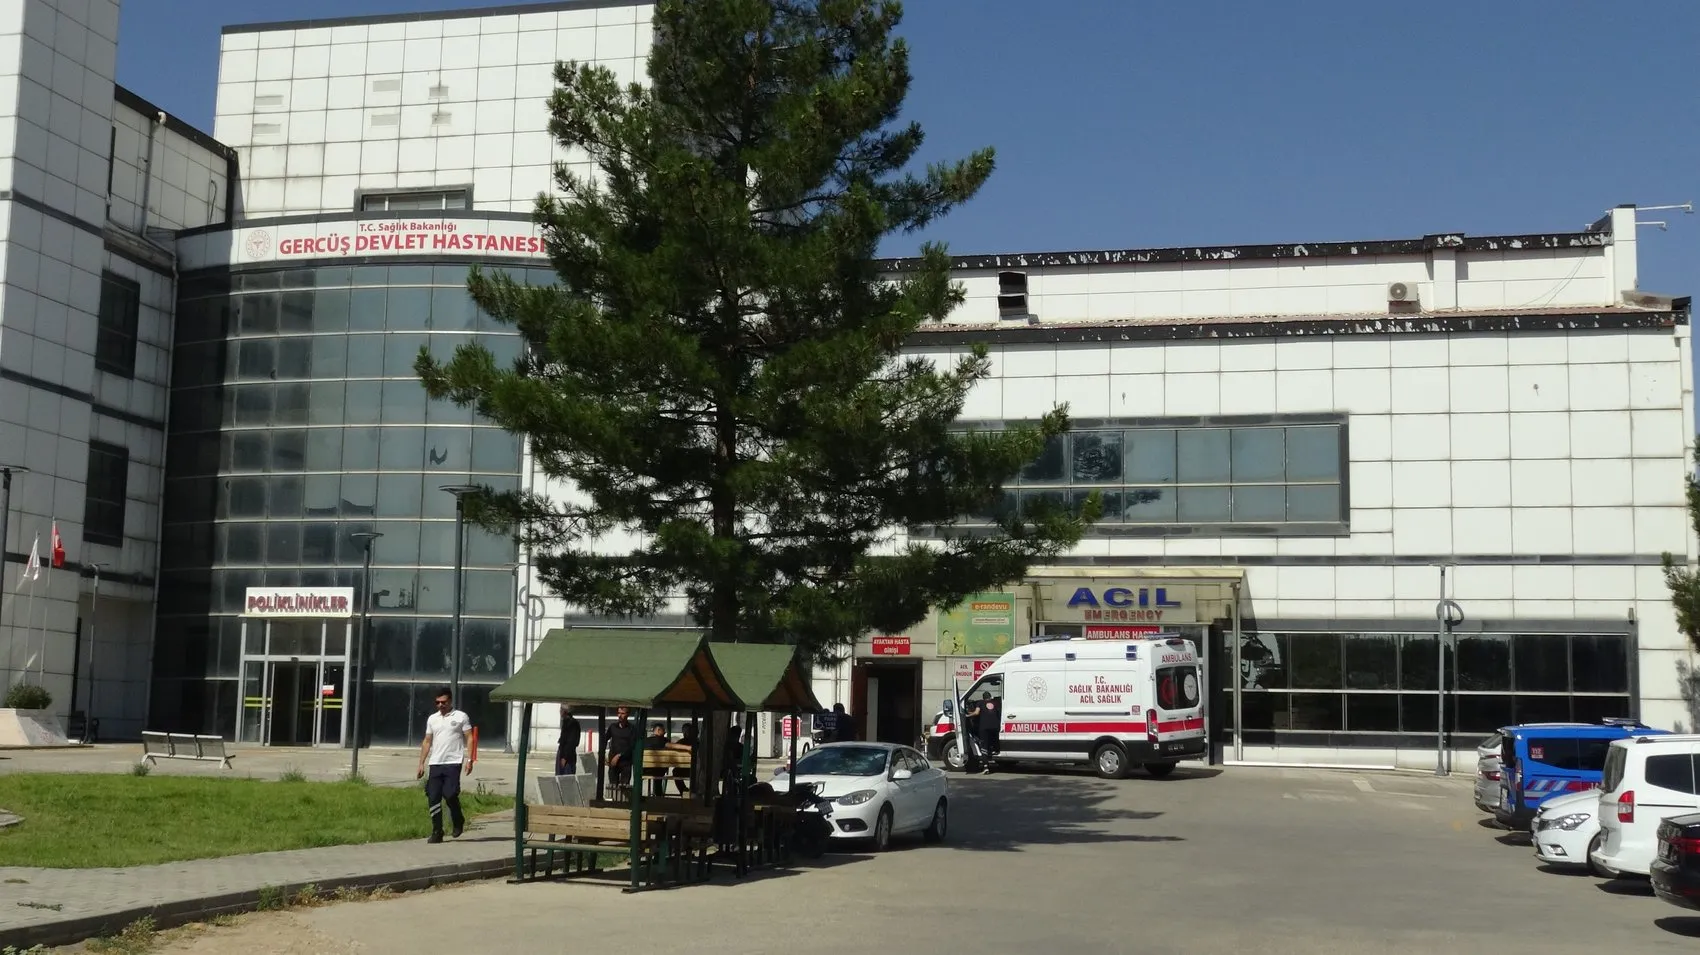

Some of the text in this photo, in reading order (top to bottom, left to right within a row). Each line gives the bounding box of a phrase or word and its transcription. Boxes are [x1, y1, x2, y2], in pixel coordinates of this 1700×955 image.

[360, 222, 457, 233] T.C. Sağlık Bakanlığı
[279, 233, 351, 255] GERCÜŞ
[355, 234, 428, 251] DEVLET
[247, 593, 348, 612] POLİKLİNİKLER
[1083, 609, 1164, 621] EMERGENCY
[1086, 630, 1130, 640] AMBULANS
[1161, 653, 1192, 663] AMBULANS
[1094, 676, 1107, 684] T.C.
[1068, 683, 1133, 693] SAĞLIK BAKANLIĞI
[1080, 694, 1122, 704] ACİL SAĞLIK
[1010, 723, 1059, 732] AMBULANS
